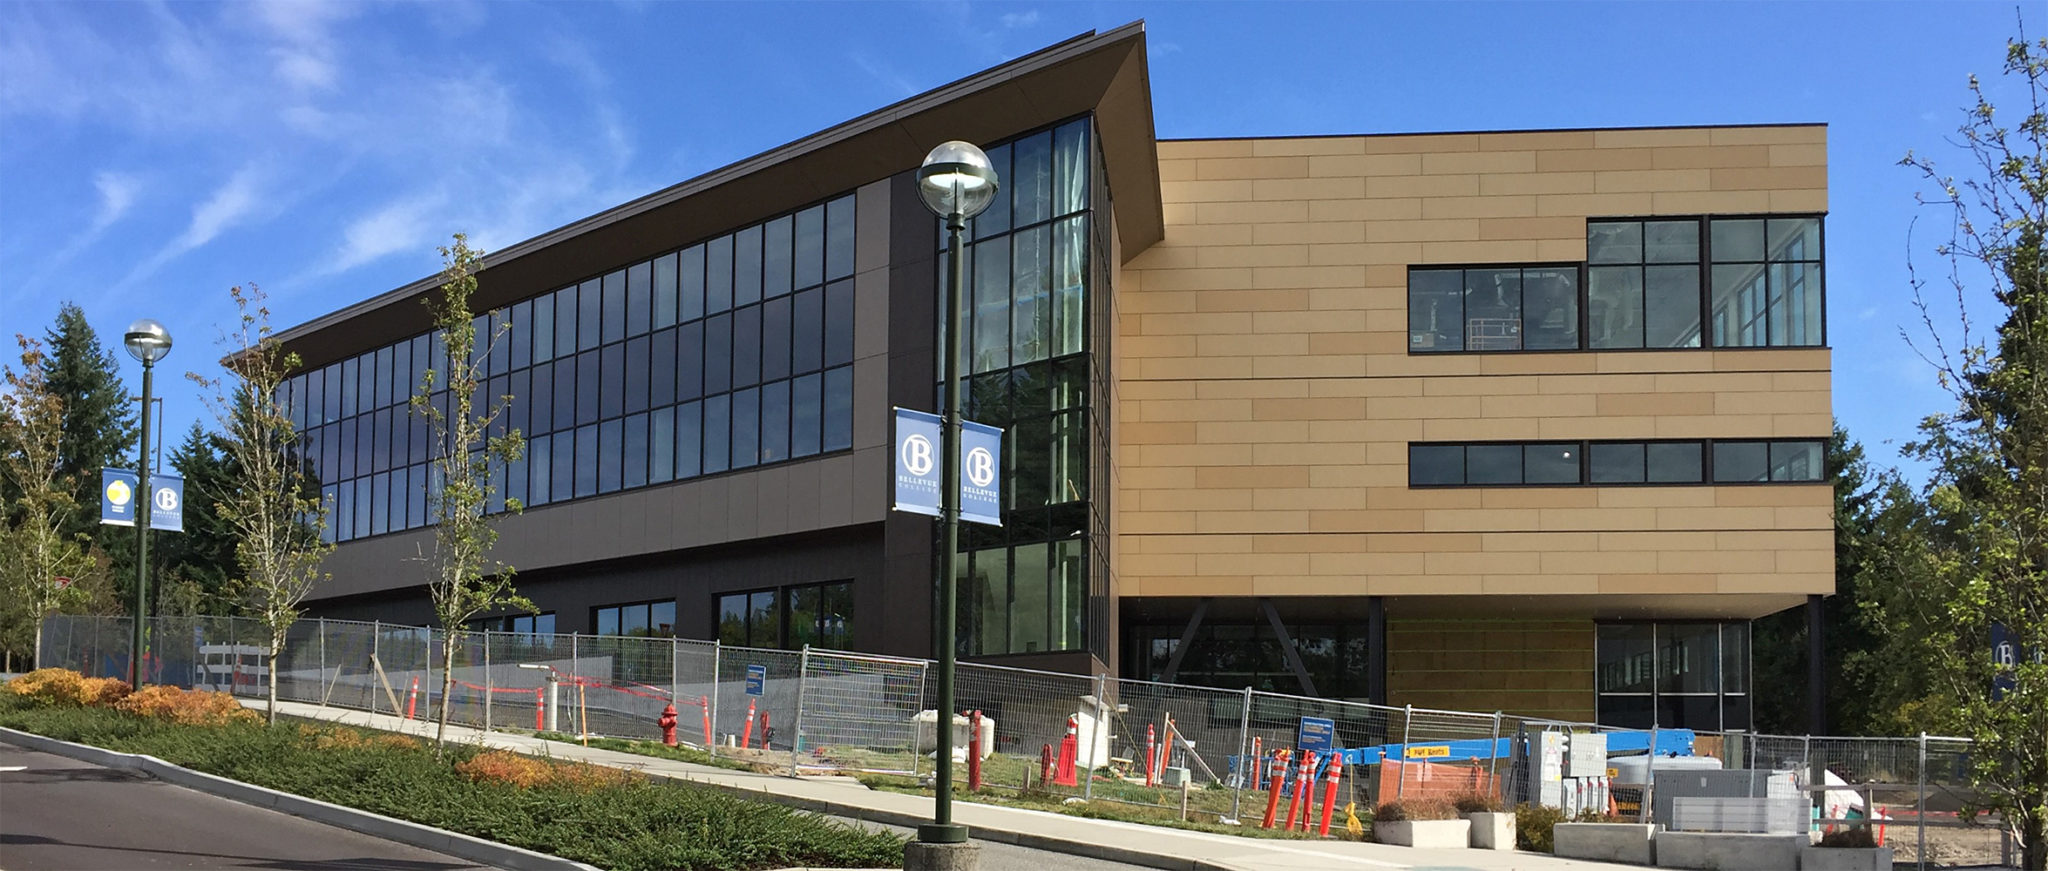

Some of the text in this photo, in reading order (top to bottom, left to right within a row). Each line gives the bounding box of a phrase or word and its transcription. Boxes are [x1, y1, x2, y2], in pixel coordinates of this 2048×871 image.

[908, 437, 934, 473] B
[972, 450, 994, 485] B
[898, 475, 937, 487] BELLEVUE
[158, 489, 178, 509] B
[963, 486, 997, 498] BELLEVUE
